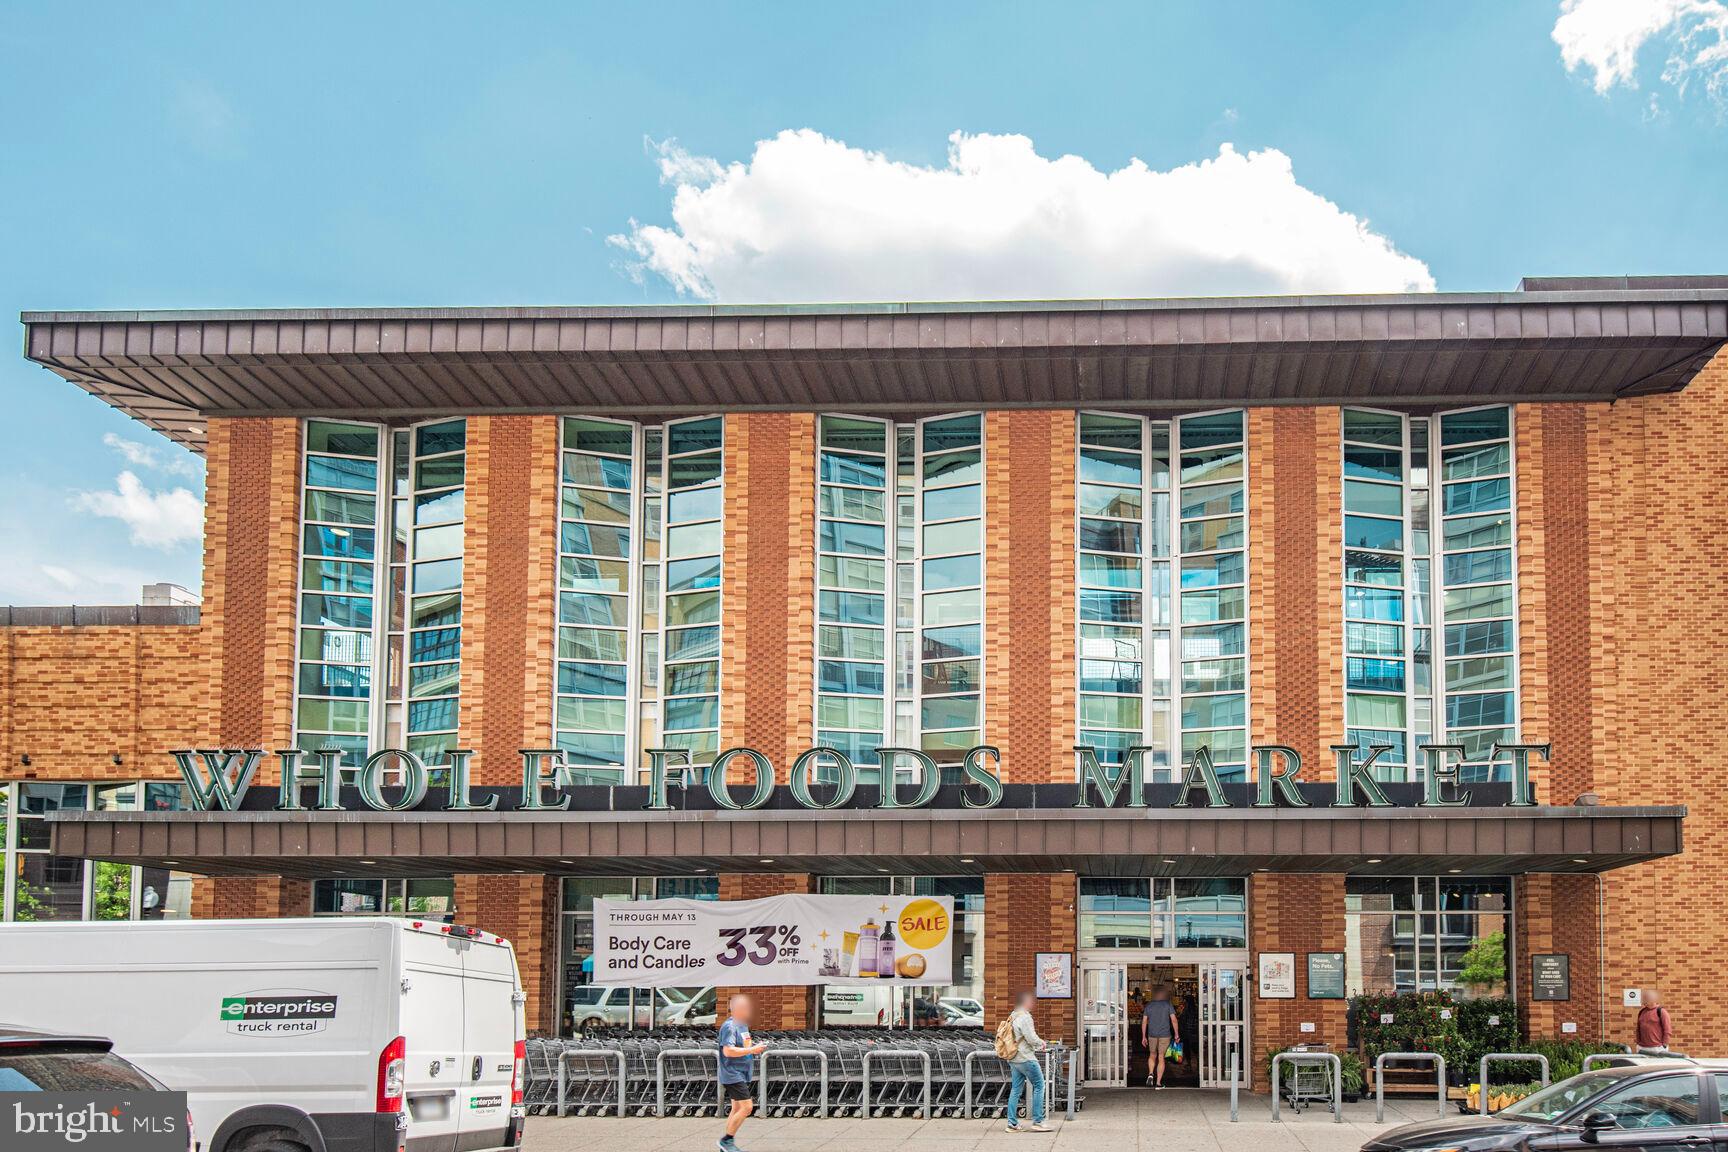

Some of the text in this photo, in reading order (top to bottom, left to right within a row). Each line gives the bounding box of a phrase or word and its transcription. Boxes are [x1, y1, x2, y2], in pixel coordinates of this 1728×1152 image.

[169, 744, 1551, 811] WHOLE FOODS MARKET
[609, 912, 697, 922] THROUGH MAY 13
[901, 915, 946, 932] SALE
[609, 936, 691, 953] Body Care
[778, 947, 800, 957] OFF
[608, 954, 706, 969] and Candles
[791, 957, 809, 965] Prime
[223, 999, 334, 1017] enterprise
[237, 1019, 317, 1032] truck rental
[470, 1097, 502, 1107] enterprise
